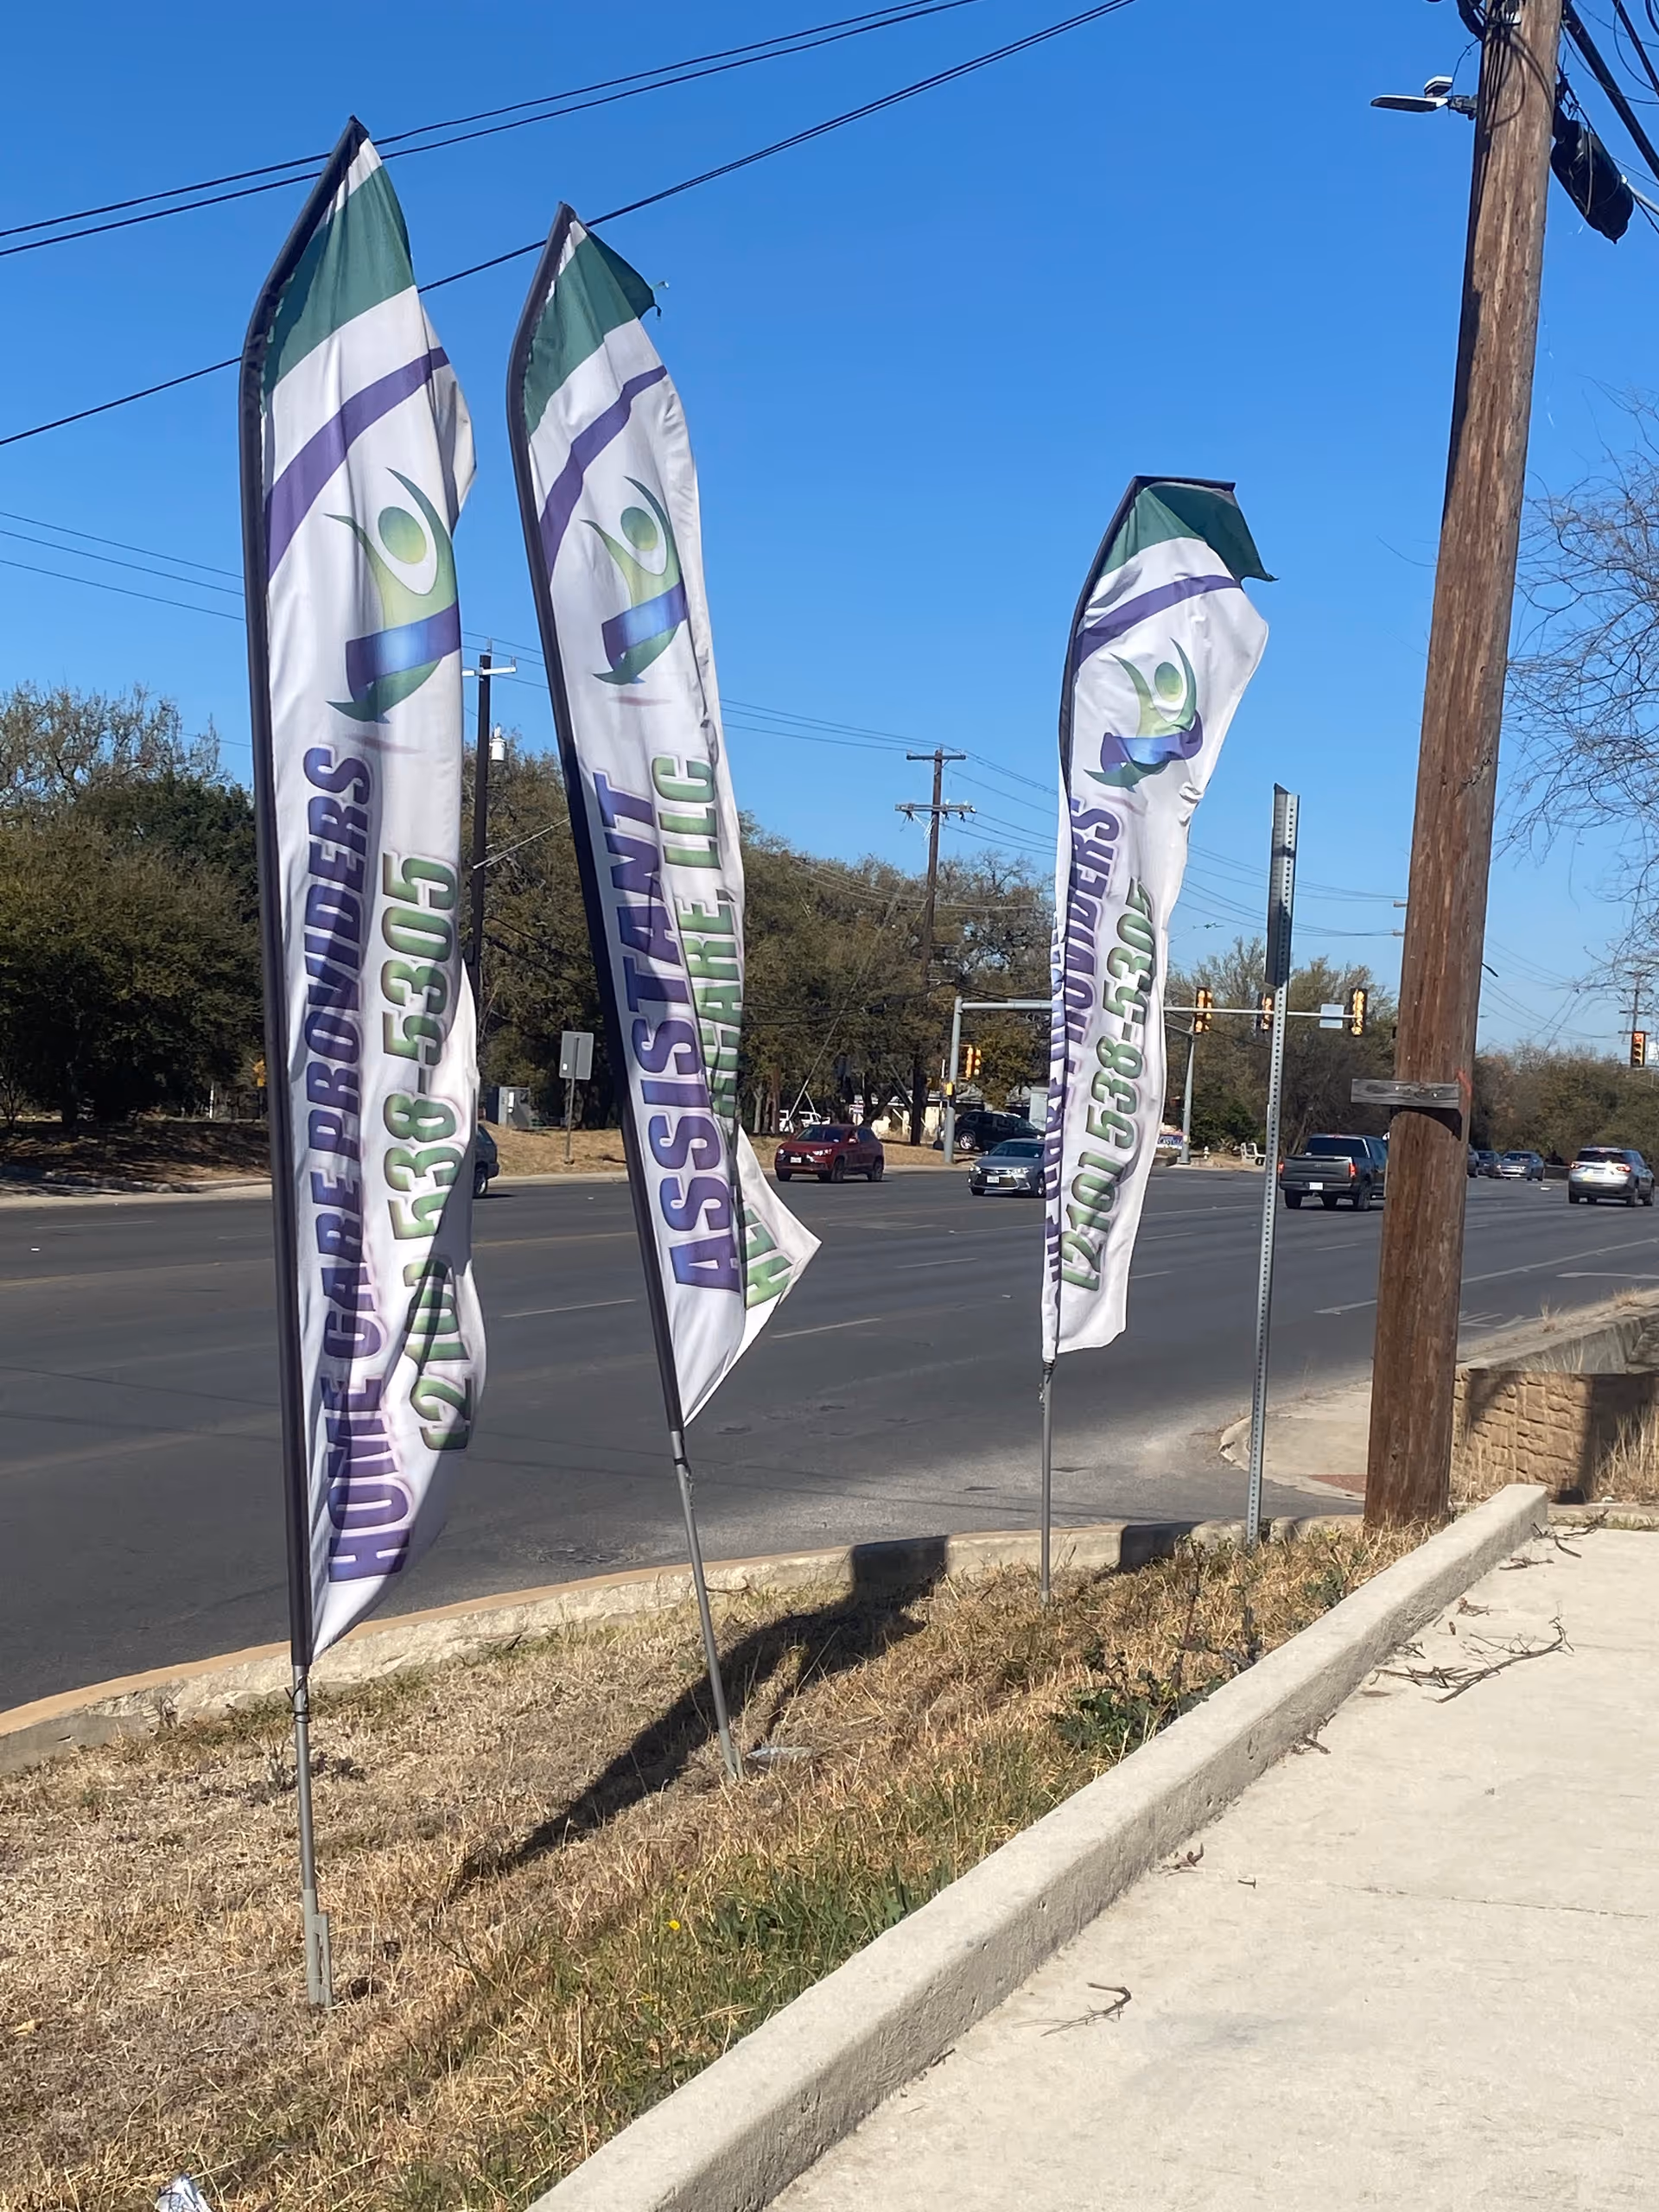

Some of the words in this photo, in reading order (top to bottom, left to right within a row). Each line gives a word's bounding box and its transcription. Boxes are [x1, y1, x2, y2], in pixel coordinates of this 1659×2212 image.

[302, 746, 371, 1160] PROVIDERS
[652, 756, 722, 870] LLC
[380, 851, 460, 1240] 538-5305
[593, 772, 741, 1294] ASSISTANT
[309, 1170, 383, 1359] CARE
[320, 1376, 413, 1583] HOME
